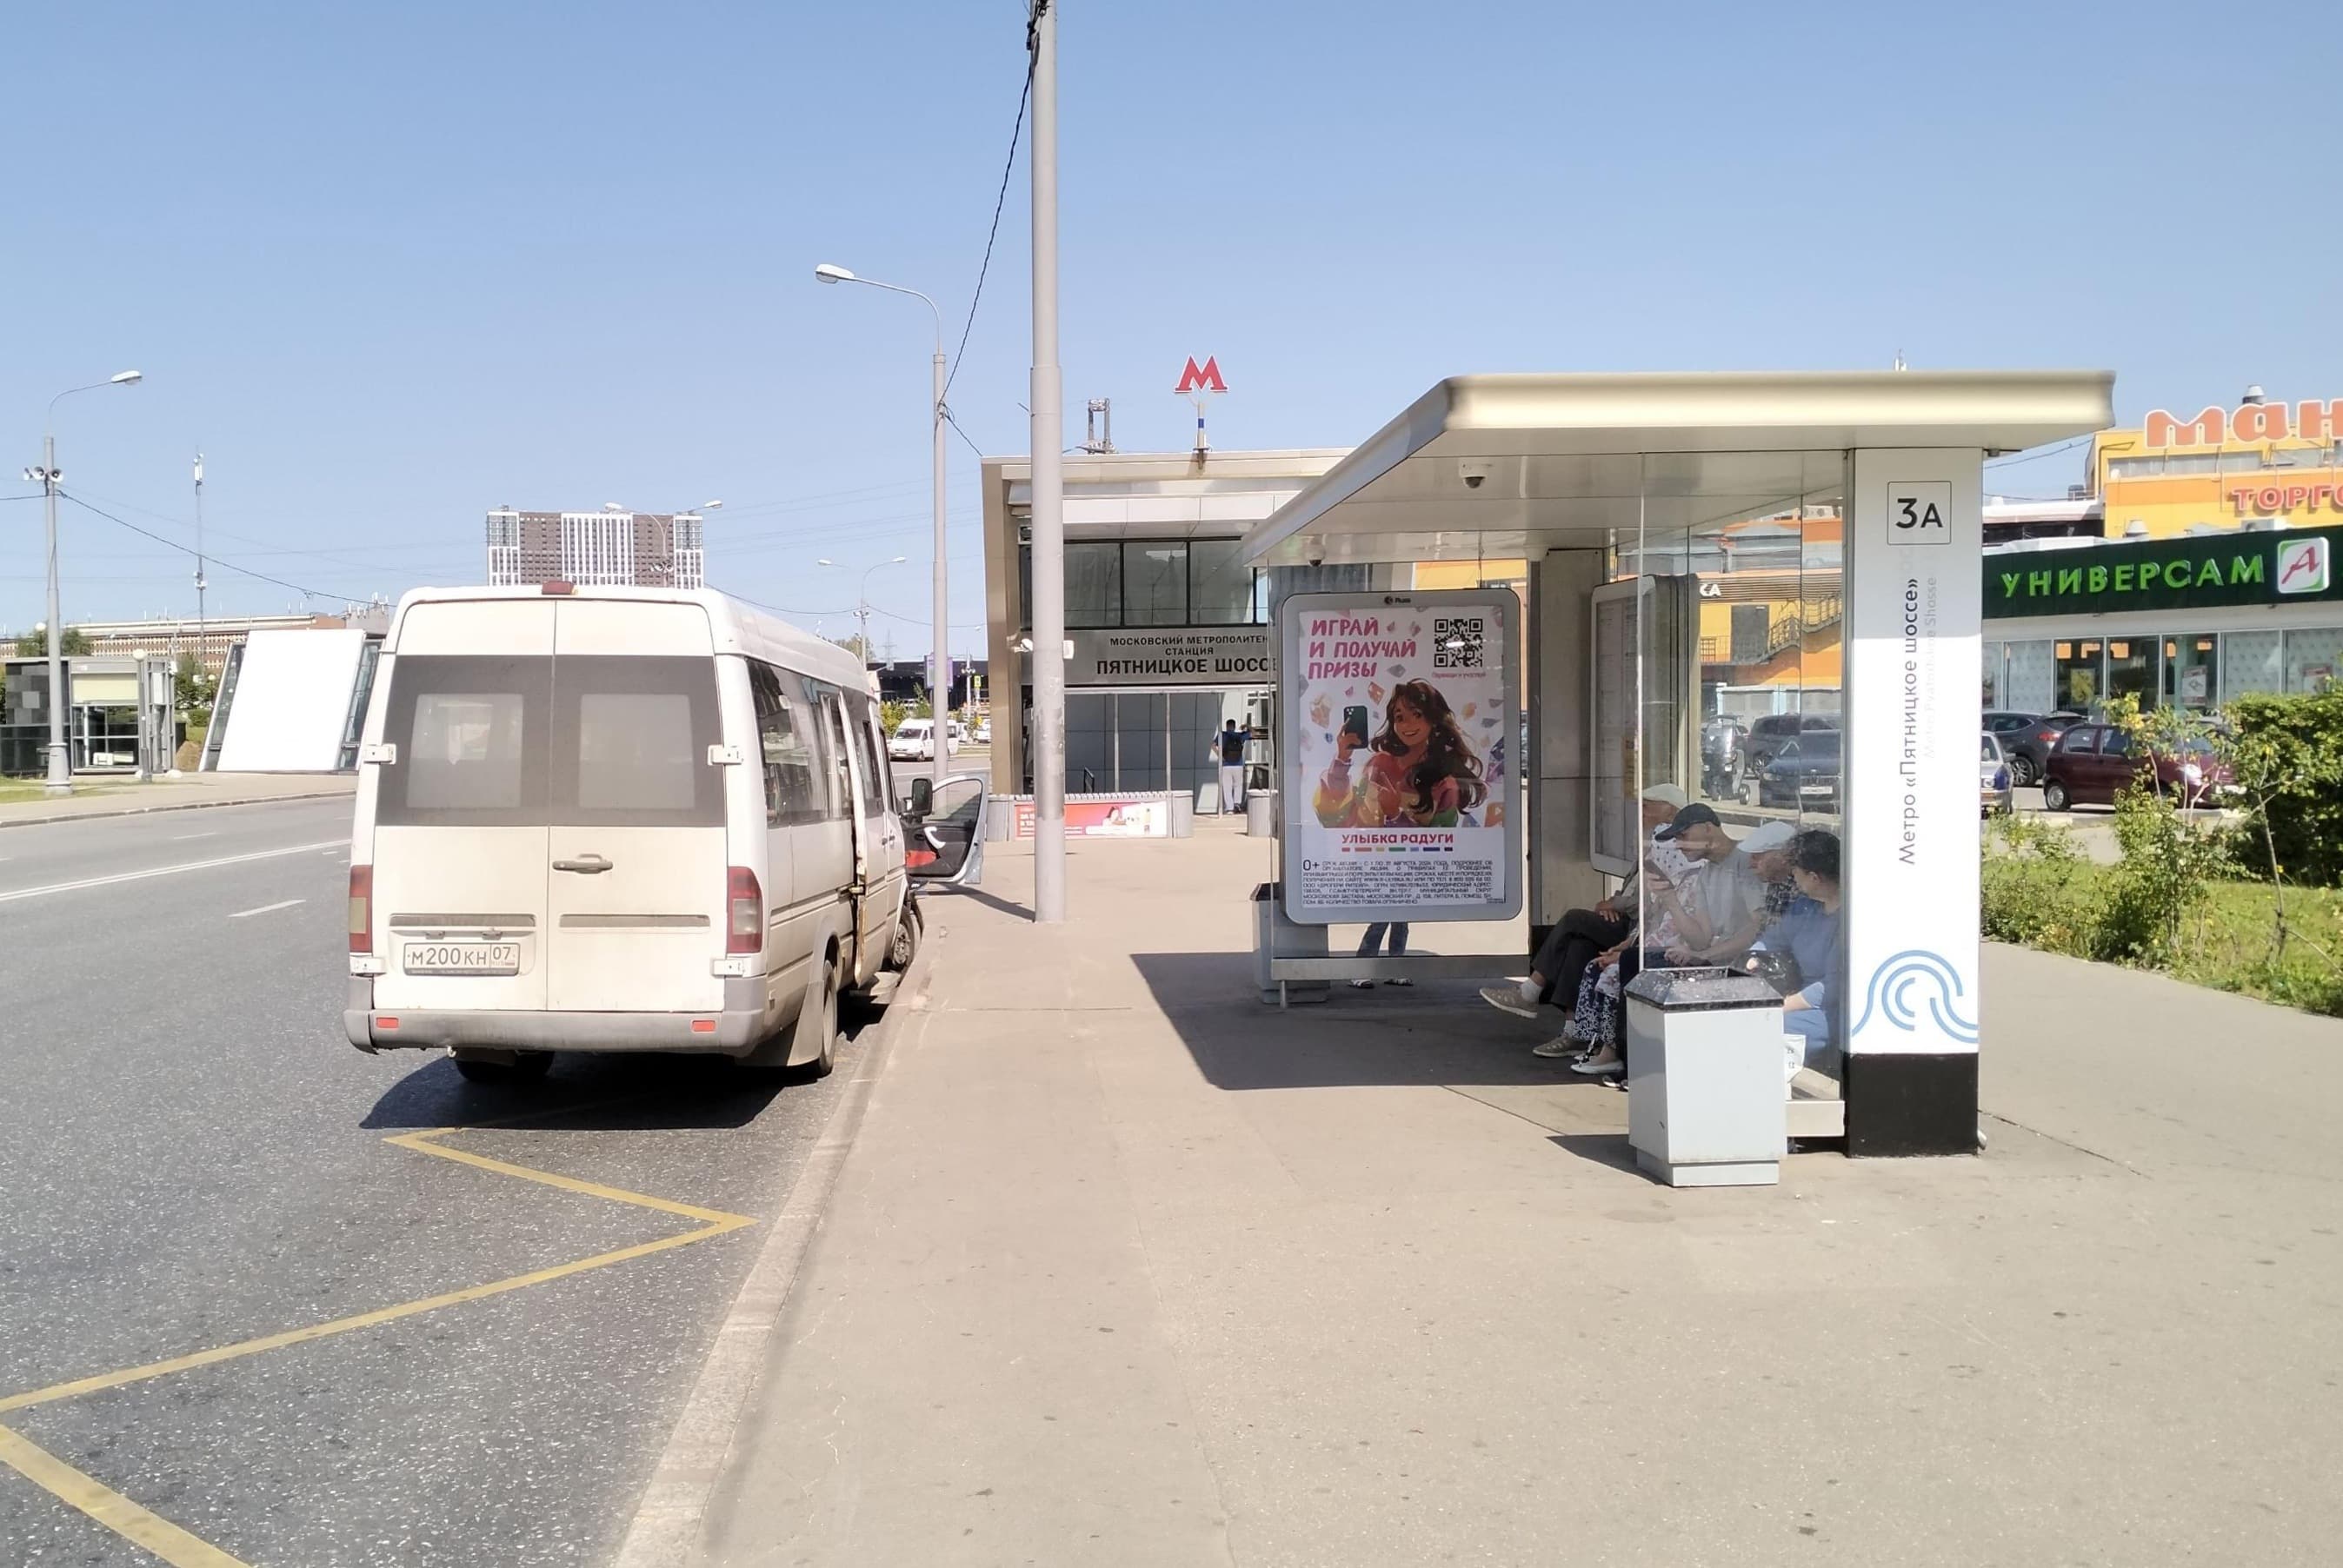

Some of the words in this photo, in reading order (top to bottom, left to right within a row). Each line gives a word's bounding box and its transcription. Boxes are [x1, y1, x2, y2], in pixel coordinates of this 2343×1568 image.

[1174, 355, 1228, 394] М
[1895, 498, 1943, 528] 3А
[2001, 553, 2265, 599] УНИВЕРСАМ
[1923, 577, 1937, 627] Shosse
[1903, 578, 1919, 654] шоссе»
[1311, 617, 1379, 636] ИГРАЙ
[1110, 636, 1183, 646] МОСКОВСКИЙ
[1309, 641, 1324, 658] И
[1334, 639, 1416, 658] ПОЛУЧАЙ
[1165, 648, 1214, 656] СТАНЦИЯ
[1097, 659, 1208, 676] ПЯТНИЦКОЕ
[1308, 661, 1378, 679] ПРИЗЫ
[1899, 660, 1920, 787] «Пятницкое
[1899, 794, 1920, 866] Метро
[1303, 860, 1320, 871] 0+
[493, 947, 511, 960] 07
